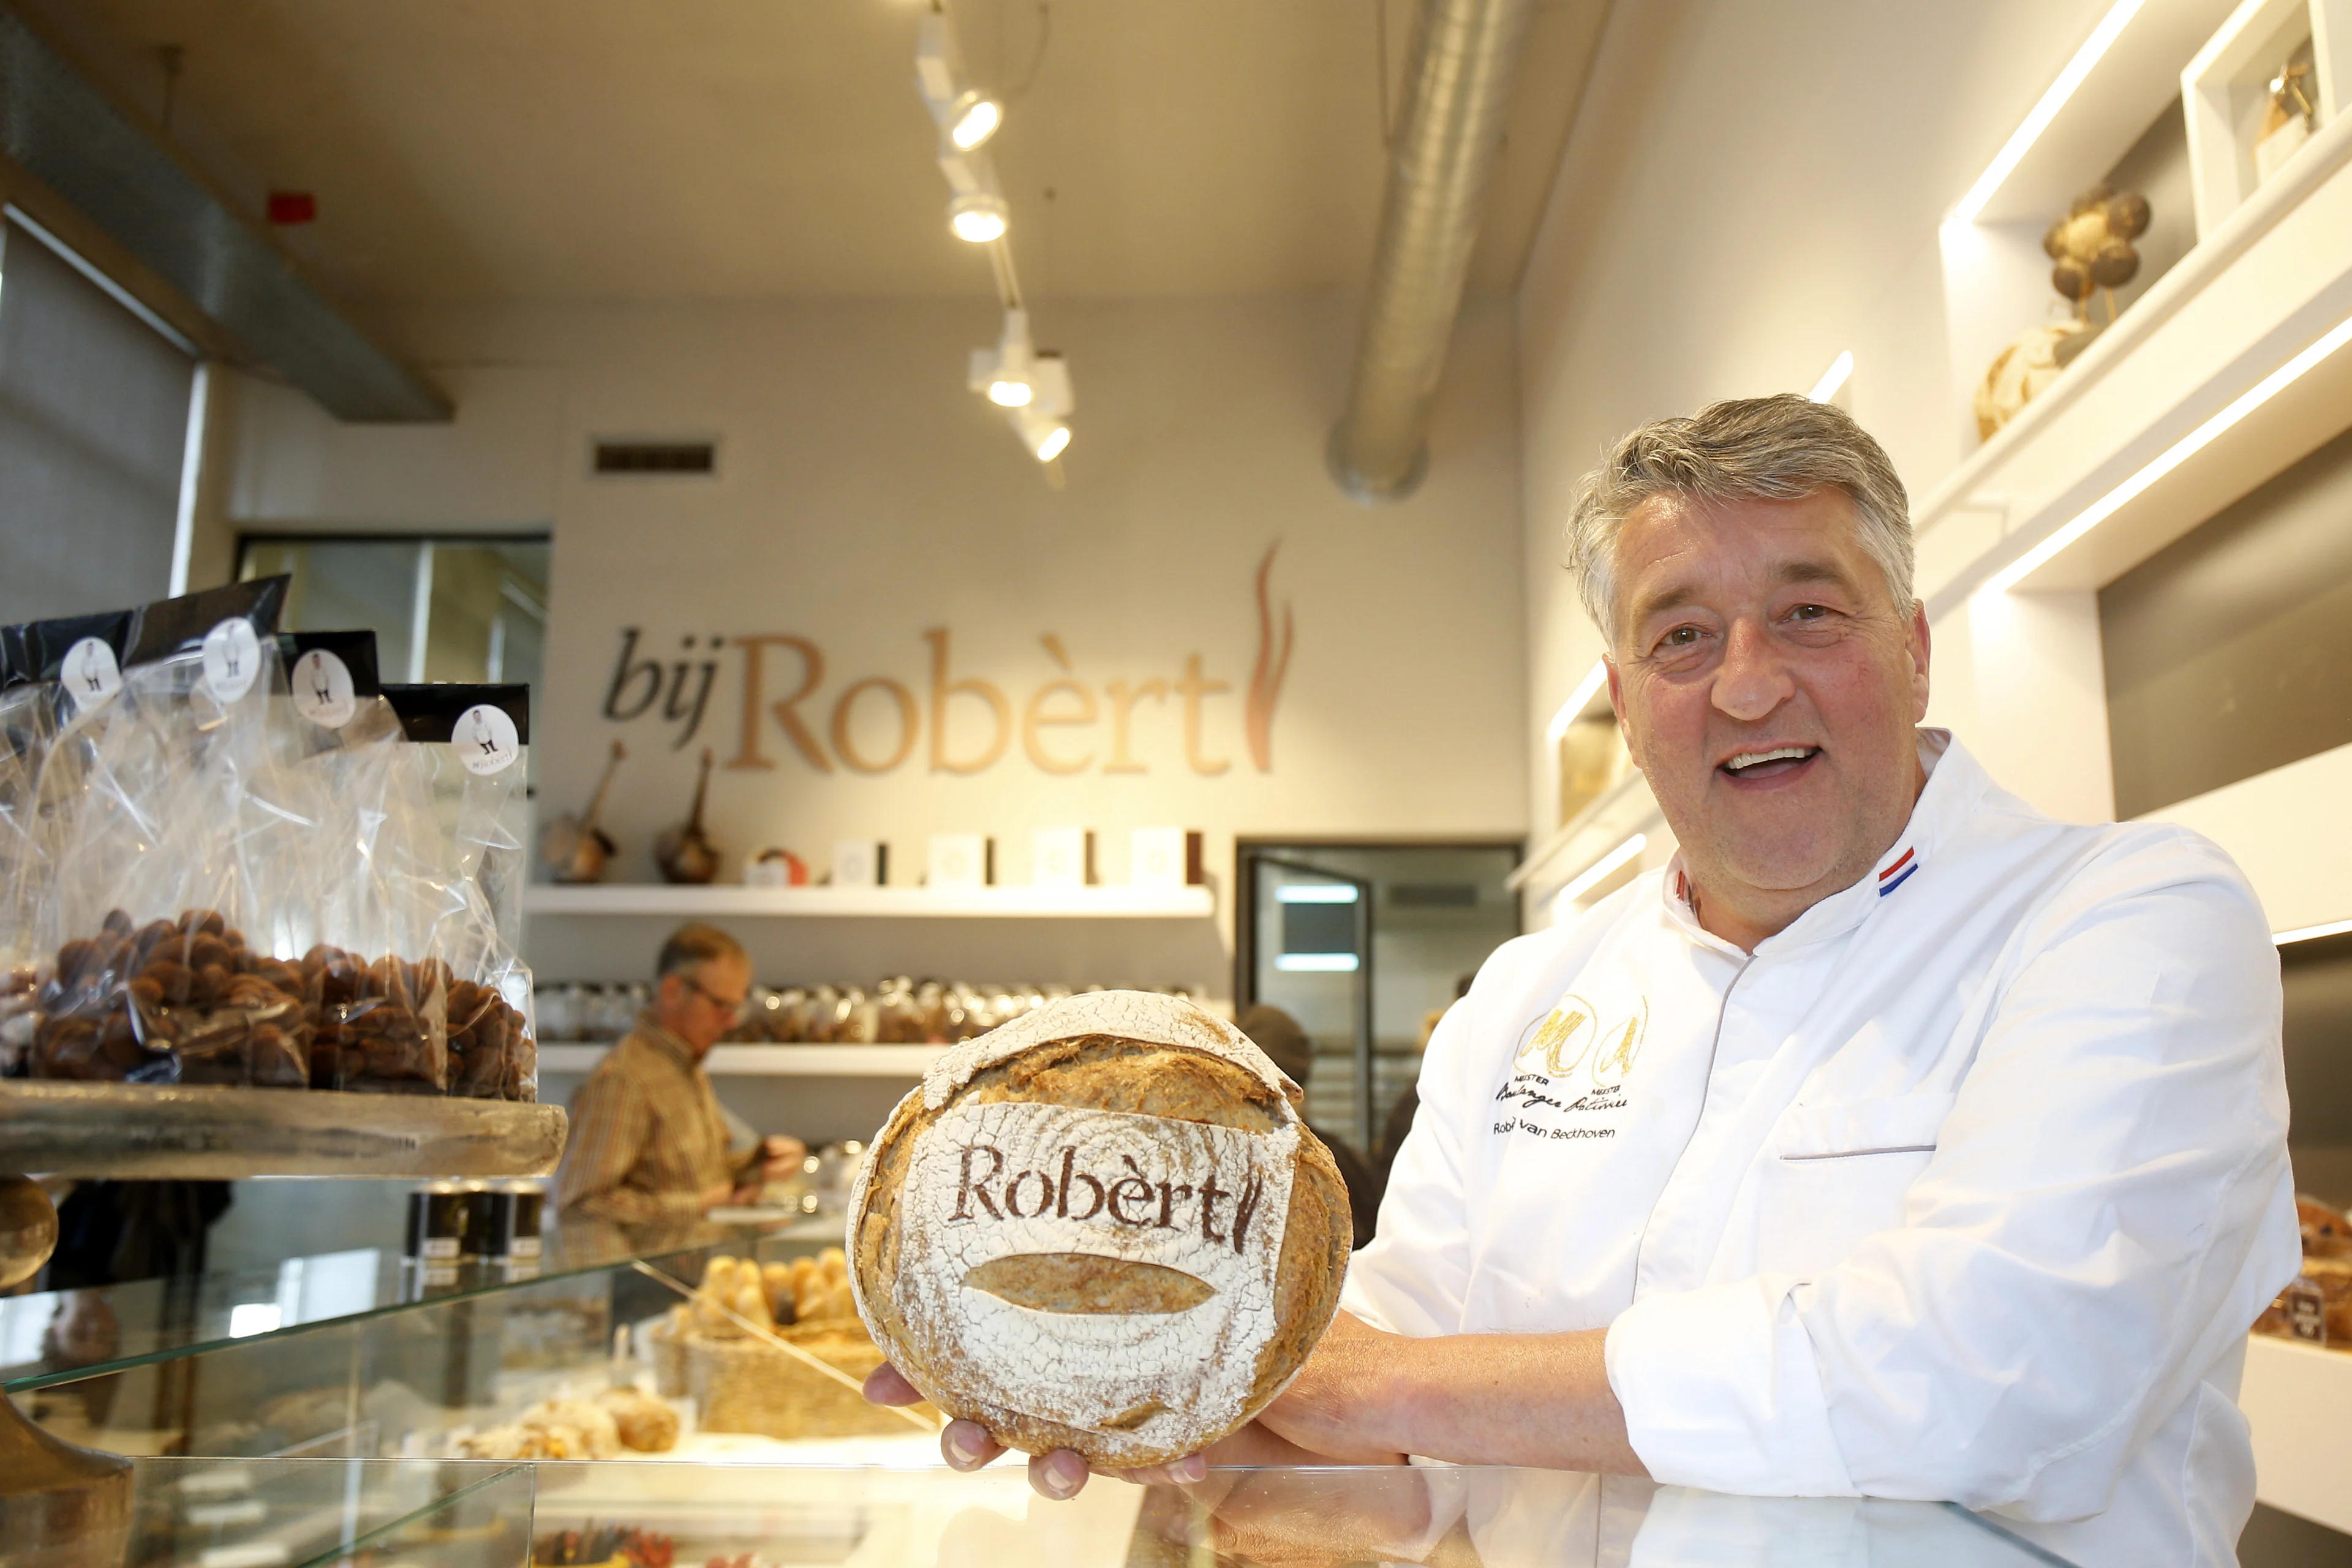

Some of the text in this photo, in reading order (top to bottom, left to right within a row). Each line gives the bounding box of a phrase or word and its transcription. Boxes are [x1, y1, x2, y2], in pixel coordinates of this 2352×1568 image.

[601, 626, 1234, 778] bij Robèrt
[1519, 1118, 1548, 1139] van
[948, 1145, 1231, 1244] Robèrt
